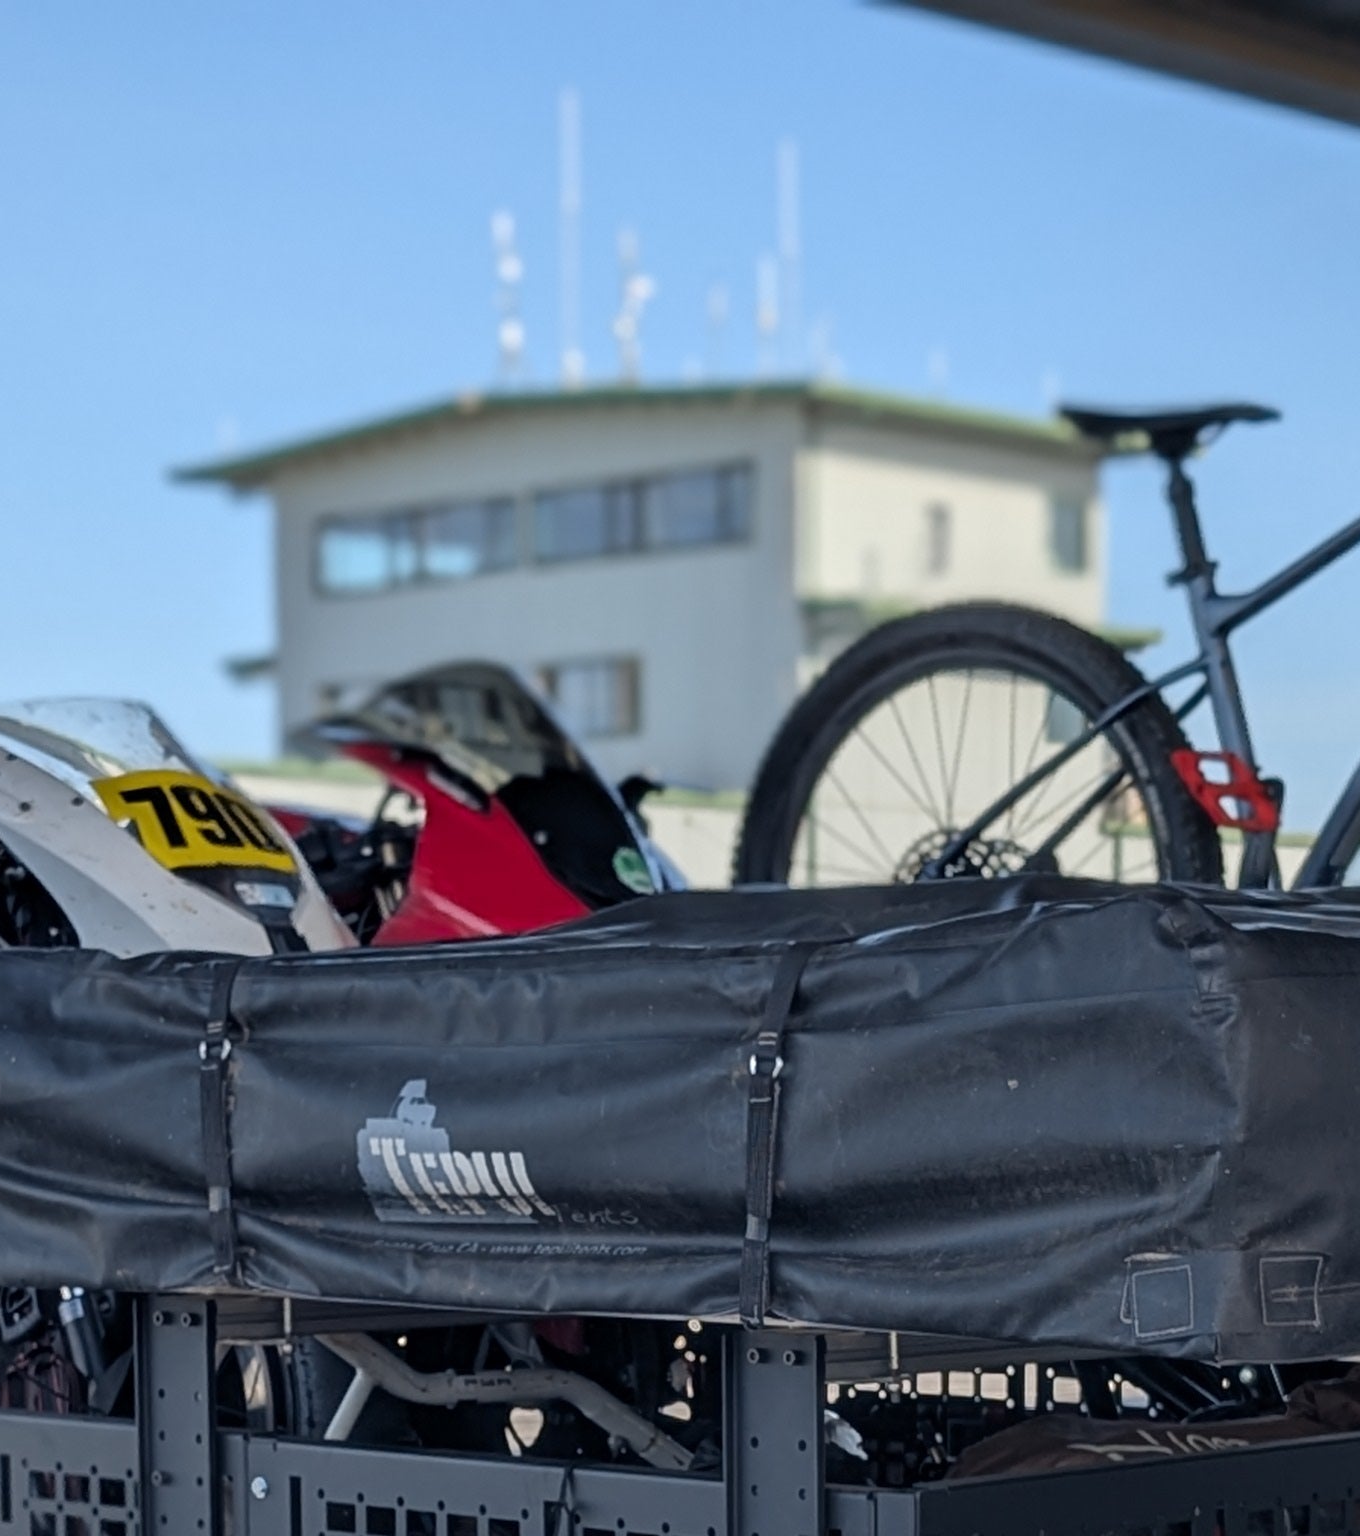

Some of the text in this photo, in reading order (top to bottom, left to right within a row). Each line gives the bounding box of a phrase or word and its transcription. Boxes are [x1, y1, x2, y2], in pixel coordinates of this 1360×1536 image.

[118, 785, 286, 855] 790
[368, 1137, 556, 1216] TEPUI
[554, 1203, 639, 1225] Tents
